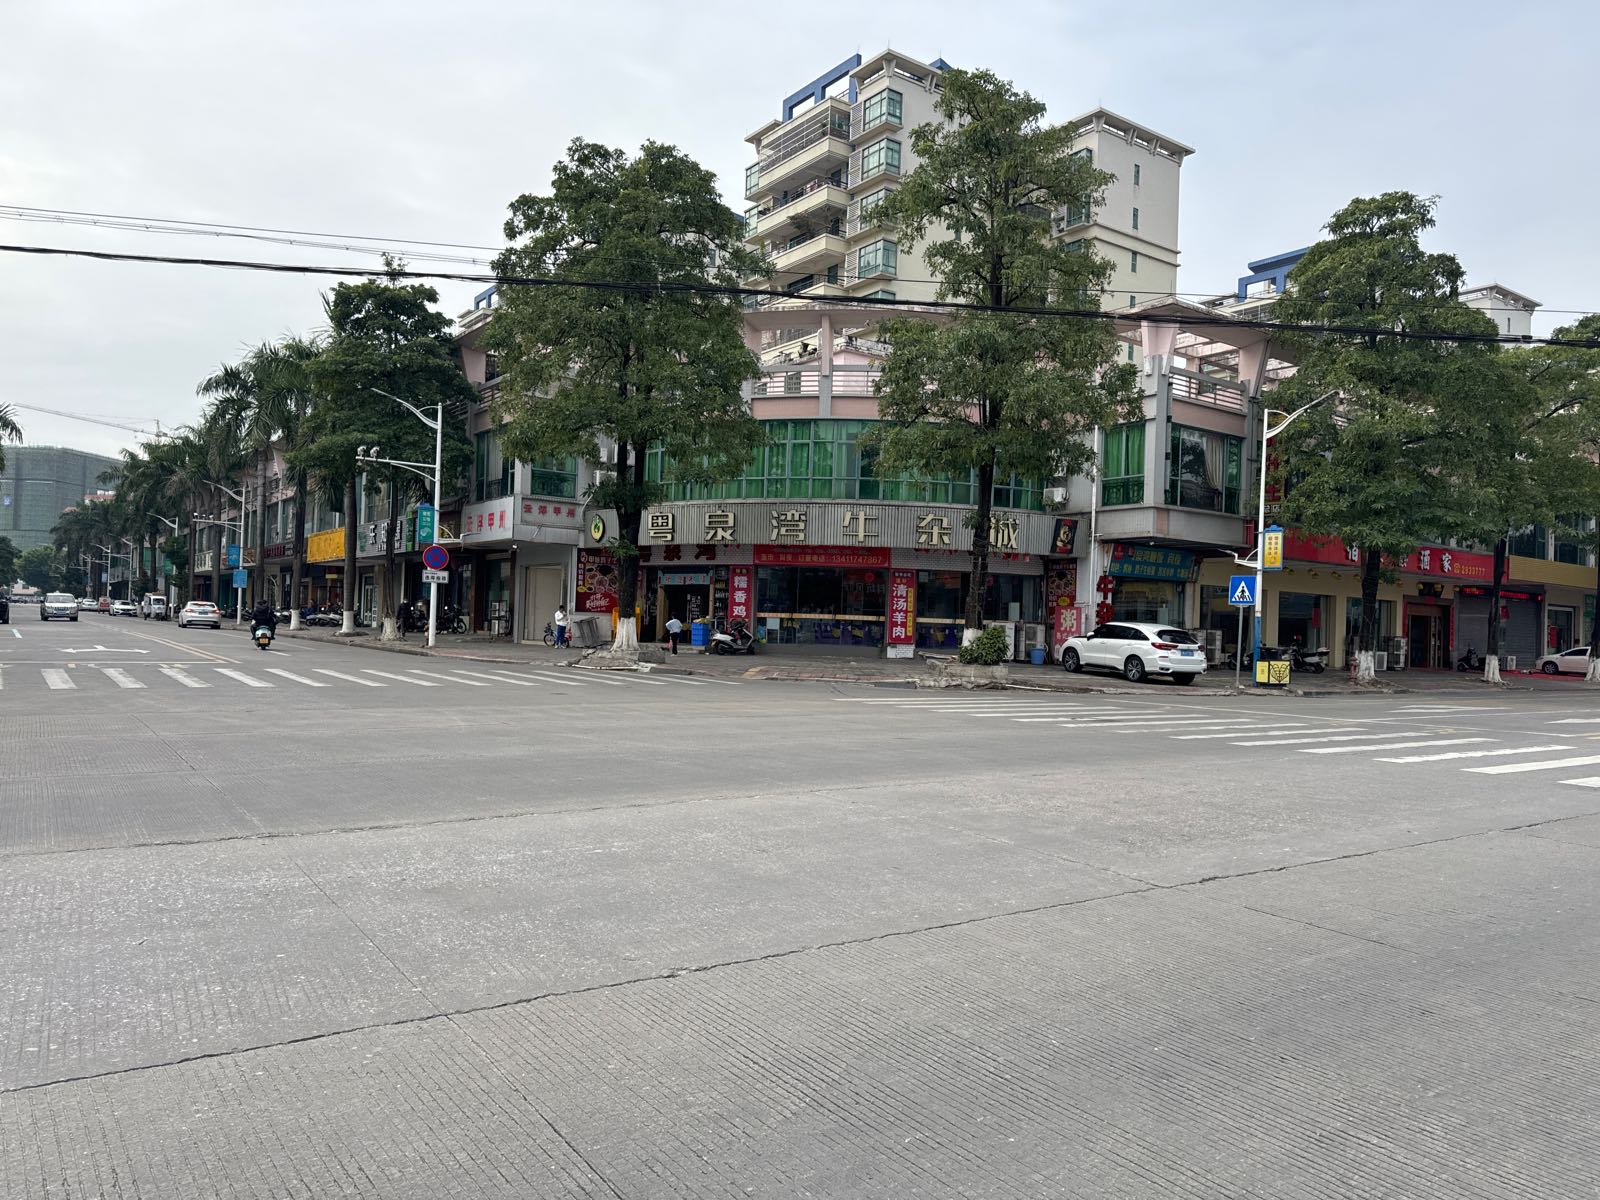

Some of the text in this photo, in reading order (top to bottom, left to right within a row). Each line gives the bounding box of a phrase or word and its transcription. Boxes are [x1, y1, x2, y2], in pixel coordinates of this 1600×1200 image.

[647, 508, 1020, 549] 粤泉湾牛杂城
[733, 575, 748, 618] 糯香鸡
[892, 583, 908, 639] 清汤羊肉
[1060, 608, 1077, 632] 粥
